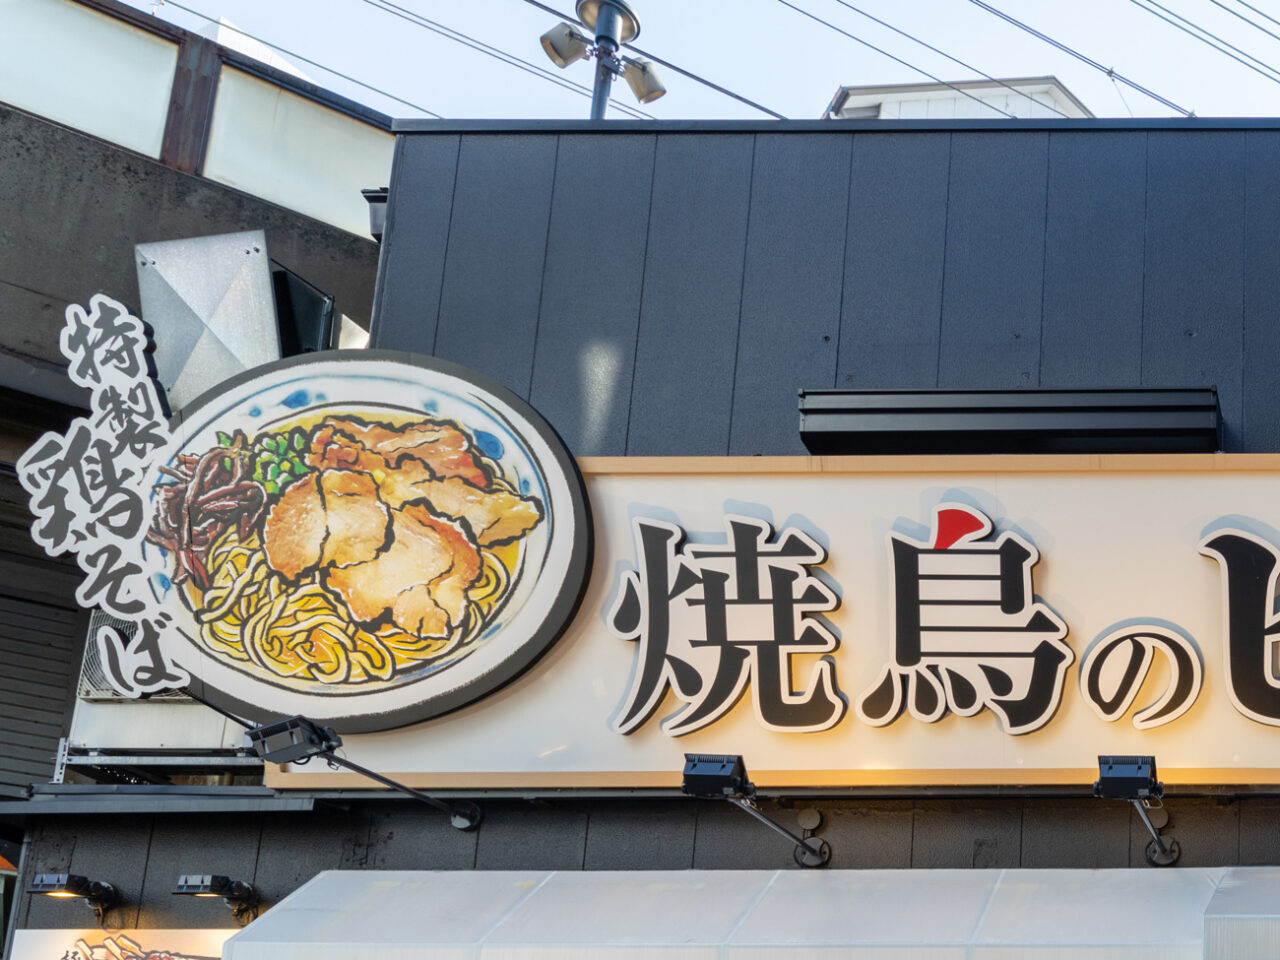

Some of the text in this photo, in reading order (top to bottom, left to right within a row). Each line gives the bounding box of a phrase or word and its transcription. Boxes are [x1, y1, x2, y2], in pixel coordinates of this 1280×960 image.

[20, 300, 185, 691] 特製鶏そば
